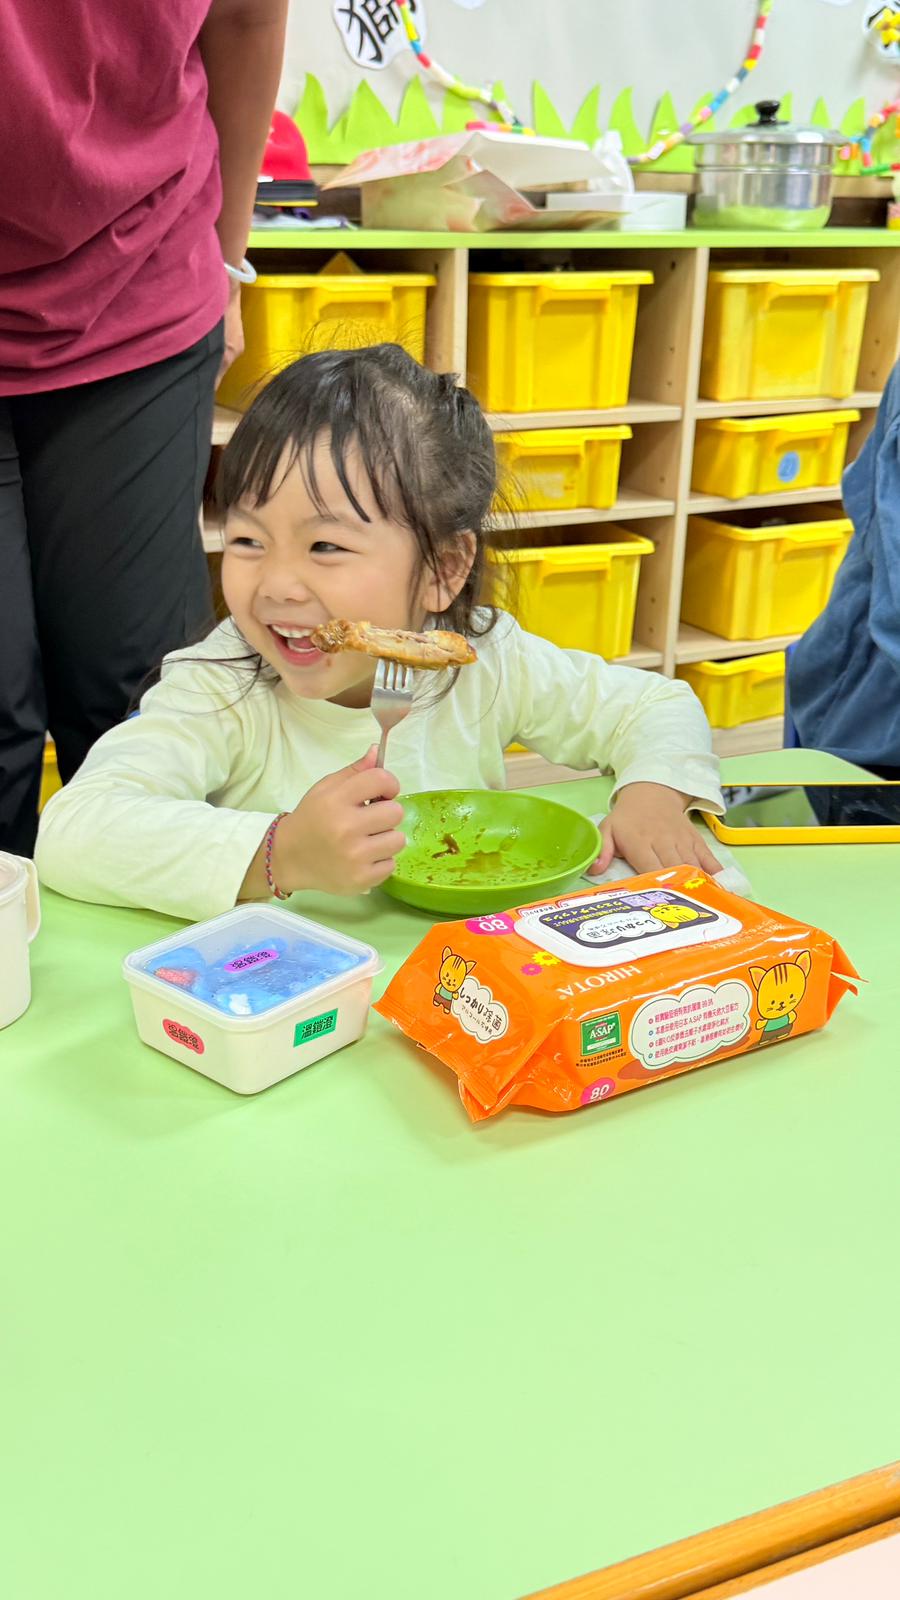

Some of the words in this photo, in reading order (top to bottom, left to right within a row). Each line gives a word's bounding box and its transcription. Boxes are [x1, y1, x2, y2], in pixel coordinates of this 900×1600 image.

[479, 919, 508, 932] 80
[556, 965, 642, 997] HIROTA
[460, 987, 503, 1031] しっかり除菌
[590, 1084, 610, 1100] 80
